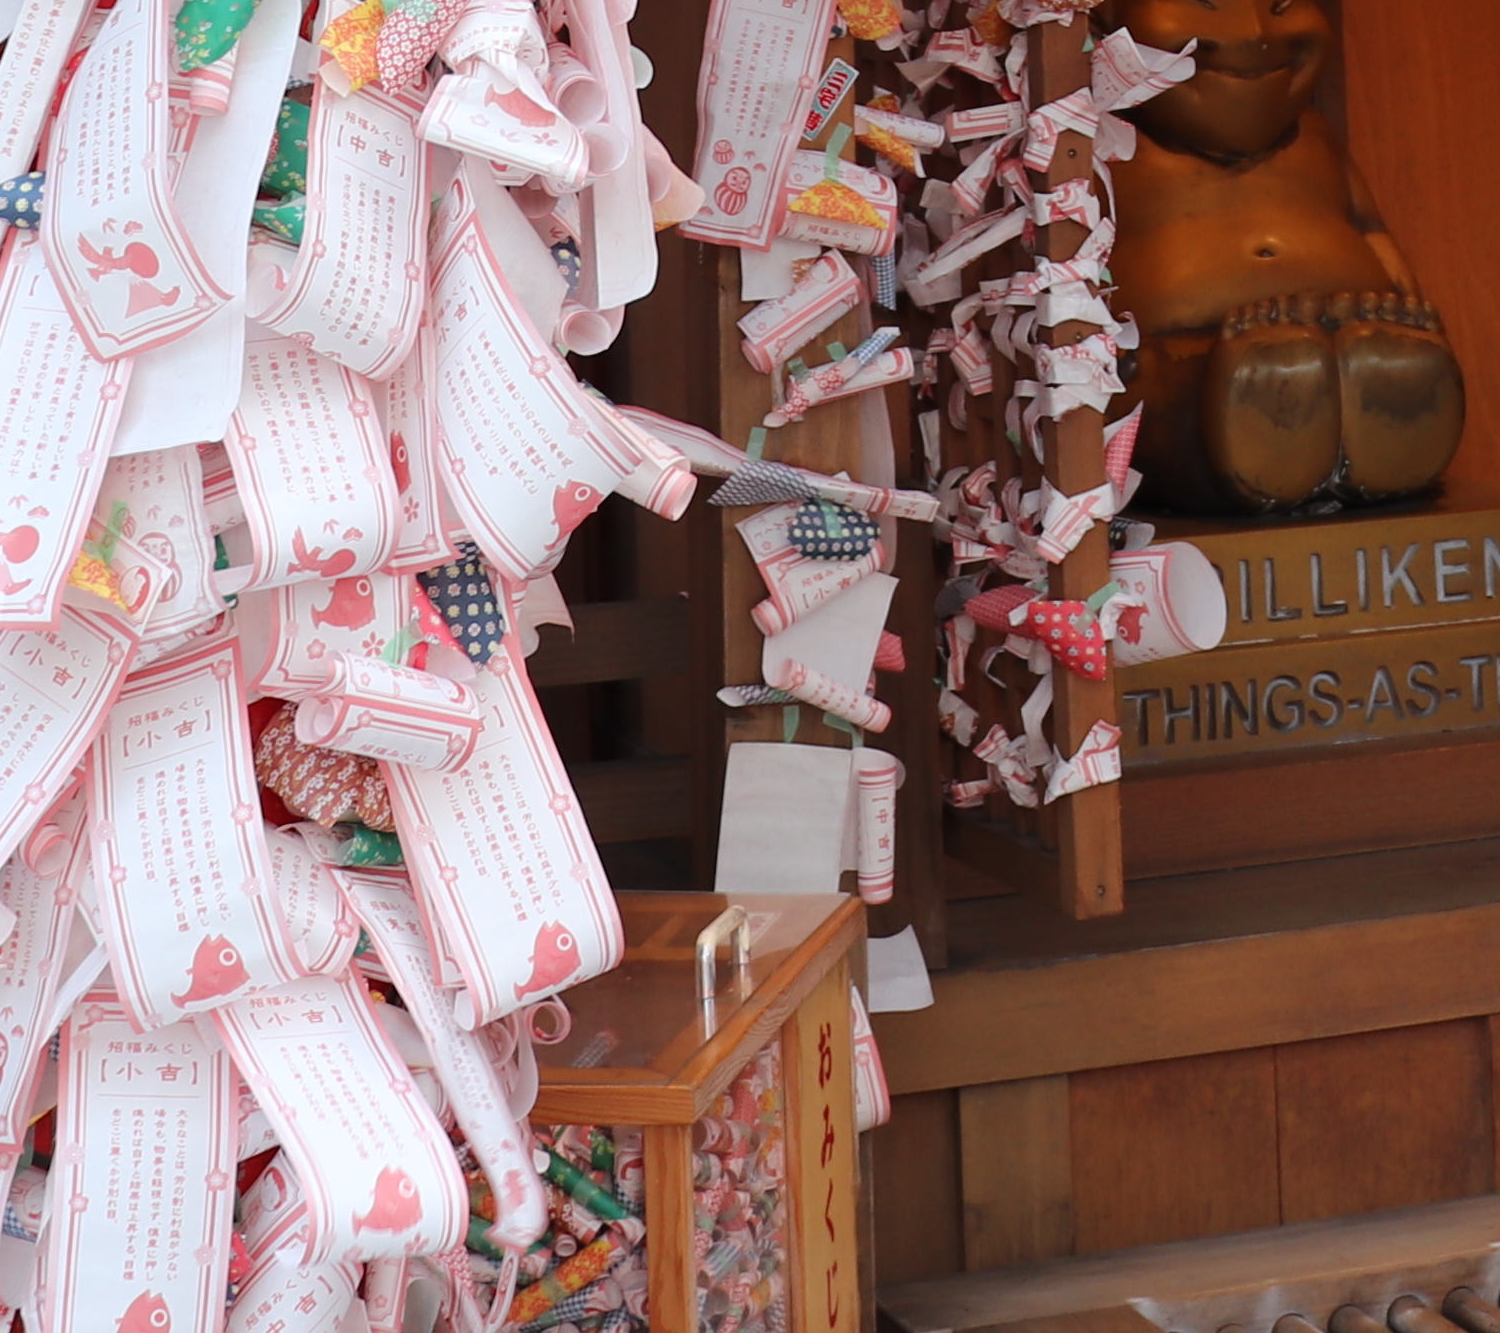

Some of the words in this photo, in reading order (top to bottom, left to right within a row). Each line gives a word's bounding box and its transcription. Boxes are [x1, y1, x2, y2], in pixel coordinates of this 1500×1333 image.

[344, 110, 404, 147] 招福みくじ
[127, 696, 204, 729] 招福みくじ
[249, 992, 328, 1009] 招福みくじ
[107, 1041, 193, 1054] 招福みくじ
[816, 1021, 842, 1330] おみくじ
